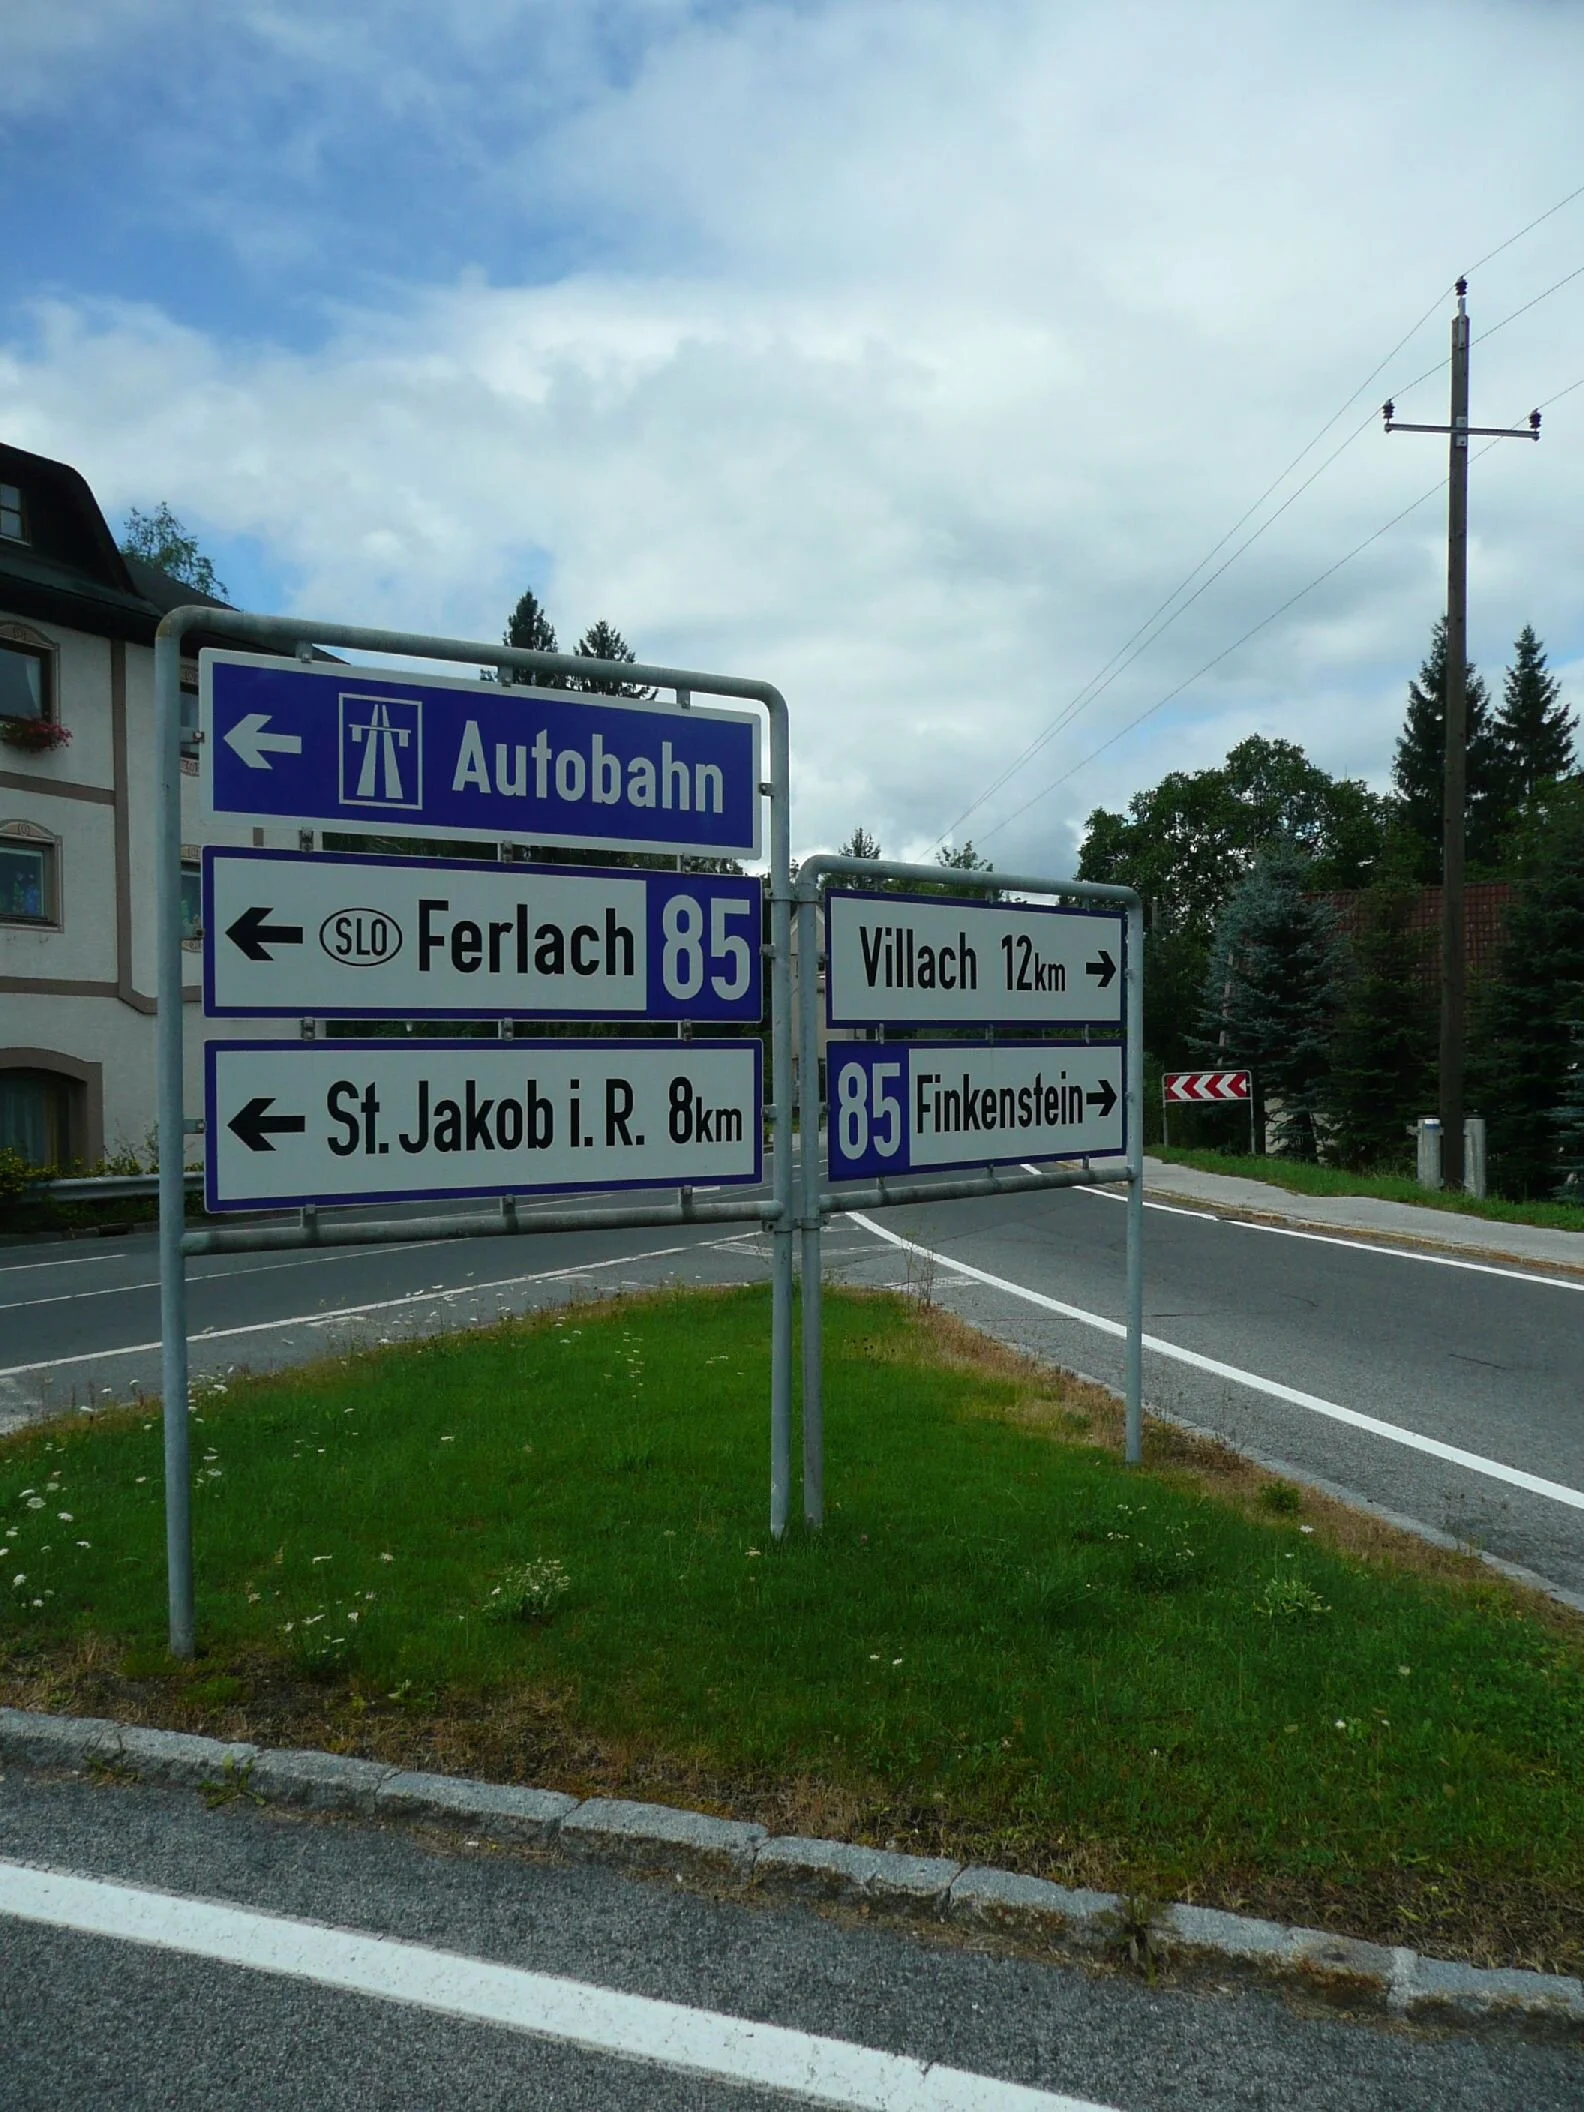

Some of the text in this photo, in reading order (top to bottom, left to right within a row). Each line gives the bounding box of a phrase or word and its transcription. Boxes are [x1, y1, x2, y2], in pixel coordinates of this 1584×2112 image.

[452, 719, 724, 814] Autobahn
[334, 893, 751, 1001] SLO Ferlach 85
[859, 926, 977, 990] Villach
[838, 1061, 1084, 1160] 85 Finkenstein
